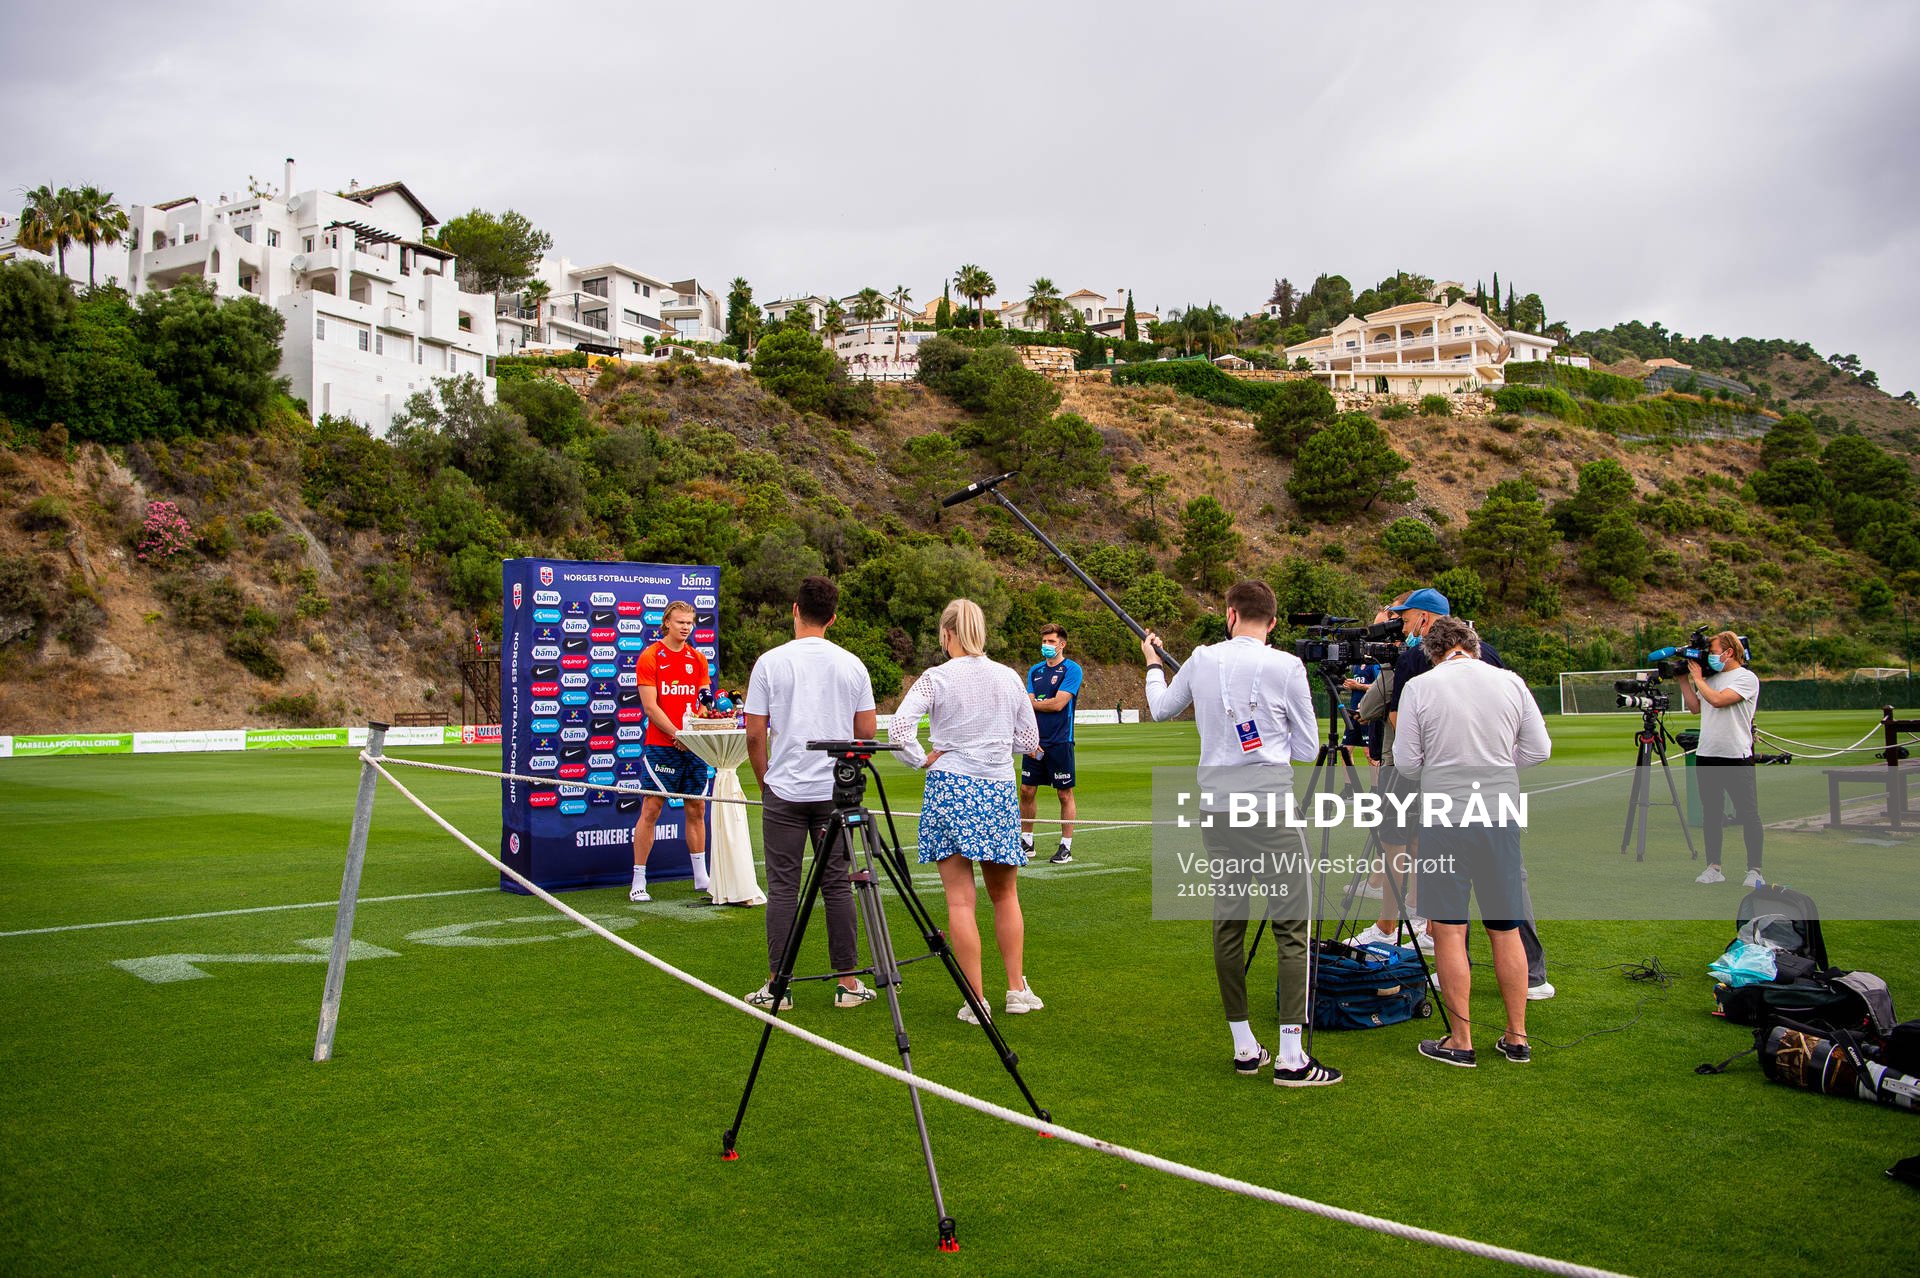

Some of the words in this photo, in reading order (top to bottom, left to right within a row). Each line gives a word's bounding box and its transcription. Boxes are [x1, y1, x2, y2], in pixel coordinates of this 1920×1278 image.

[564, 574, 597, 582] NORGES
[599, 574, 671, 585] FOTBALLFORBUND
[681, 573, 712, 586] bama
[536, 593, 559, 601] bama
[593, 594, 613, 602] bama
[646, 596, 666, 605] bama
[696, 597, 714, 605] bama
[565, 621, 587, 629] bama
[620, 622, 640, 630] bama
[535, 648, 557, 657] bama
[593, 648, 614, 657] bama
[511, 632, 519, 683] NORGES
[564, 675, 586, 684] bama
[621, 675, 637, 684] bam
[661, 680, 696, 695] bama
[534, 703, 557, 712] bama
[593, 702, 614, 711] bama
[478, 727, 502, 736] WELC
[564, 730, 586, 739] bama
[620, 728, 640, 737] bama
[15, 741, 55, 749] MARBELLA
[55, 740, 93, 748] FOOTBALL
[94, 739, 120, 747] CENTER
[532, 758, 555, 767] bama
[591, 756, 612, 765] bama
[655, 764, 676, 774] bama
[576, 828, 629, 847] STERKERE
[632, 824, 678, 843] MEN
